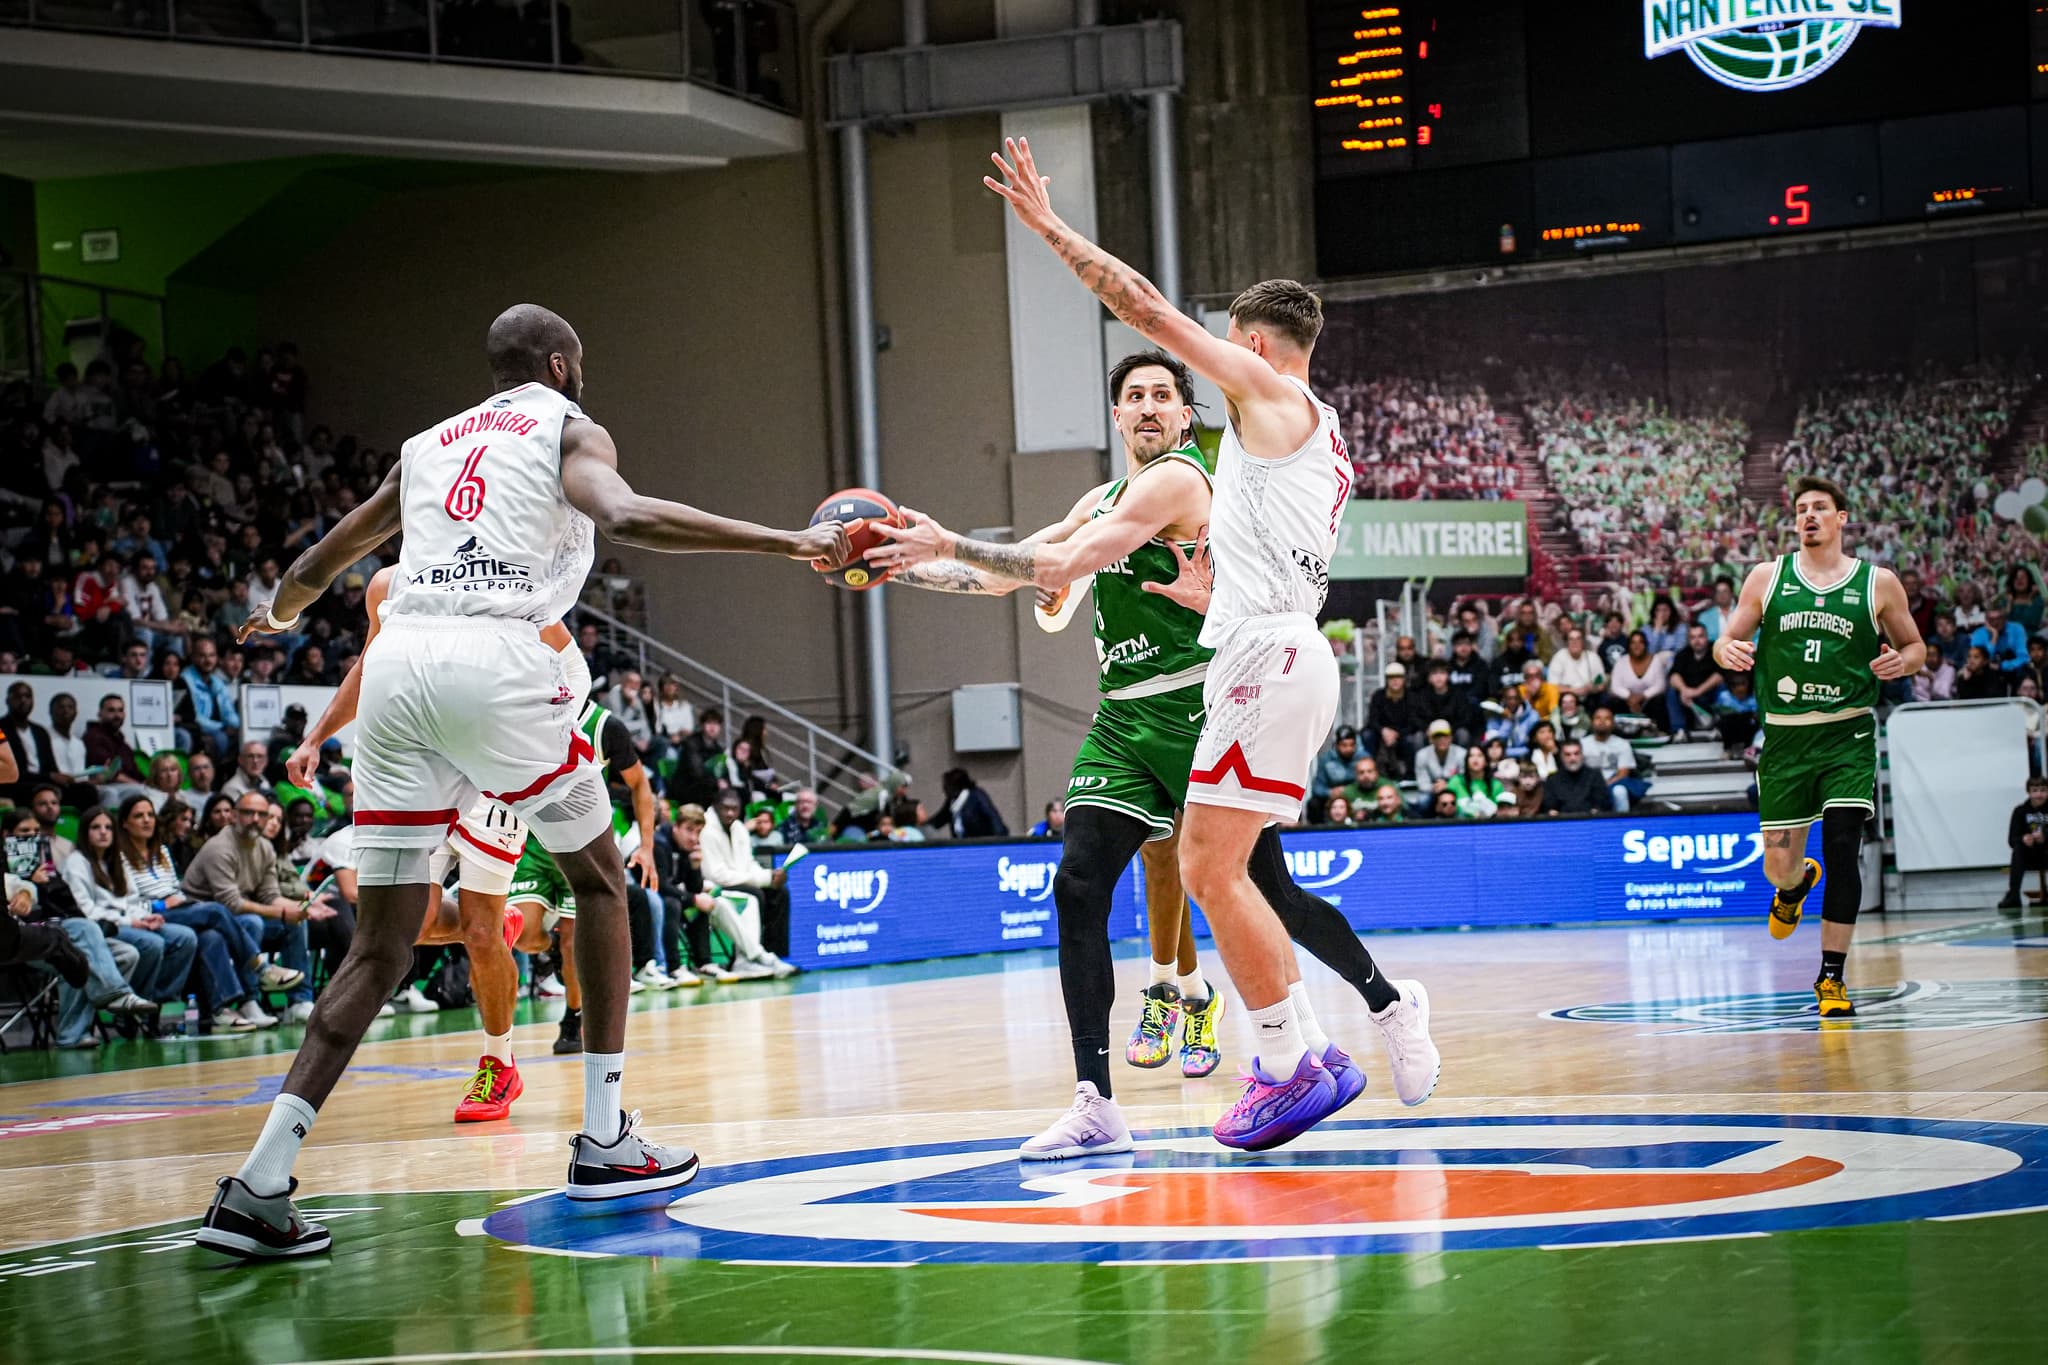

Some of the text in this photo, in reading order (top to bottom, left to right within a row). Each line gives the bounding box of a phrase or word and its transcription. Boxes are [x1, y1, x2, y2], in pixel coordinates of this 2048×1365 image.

[440, 411, 539, 447] DIAWARA
[444, 445, 488, 522] 6
[1362, 521, 1523, 557] NANTERRE!
[430, 559, 530, 584] BLOTTIE
[1779, 610, 1854, 640] NANTERRE92
[1283, 647, 1297, 675] 7
[1804, 638, 1822, 663] 21
[1802, 683, 1841, 697] GTM
[1622, 829, 1740, 870] Sepur
[813, 864, 876, 910] Sepur
[998, 856, 1047, 897] Sepur
